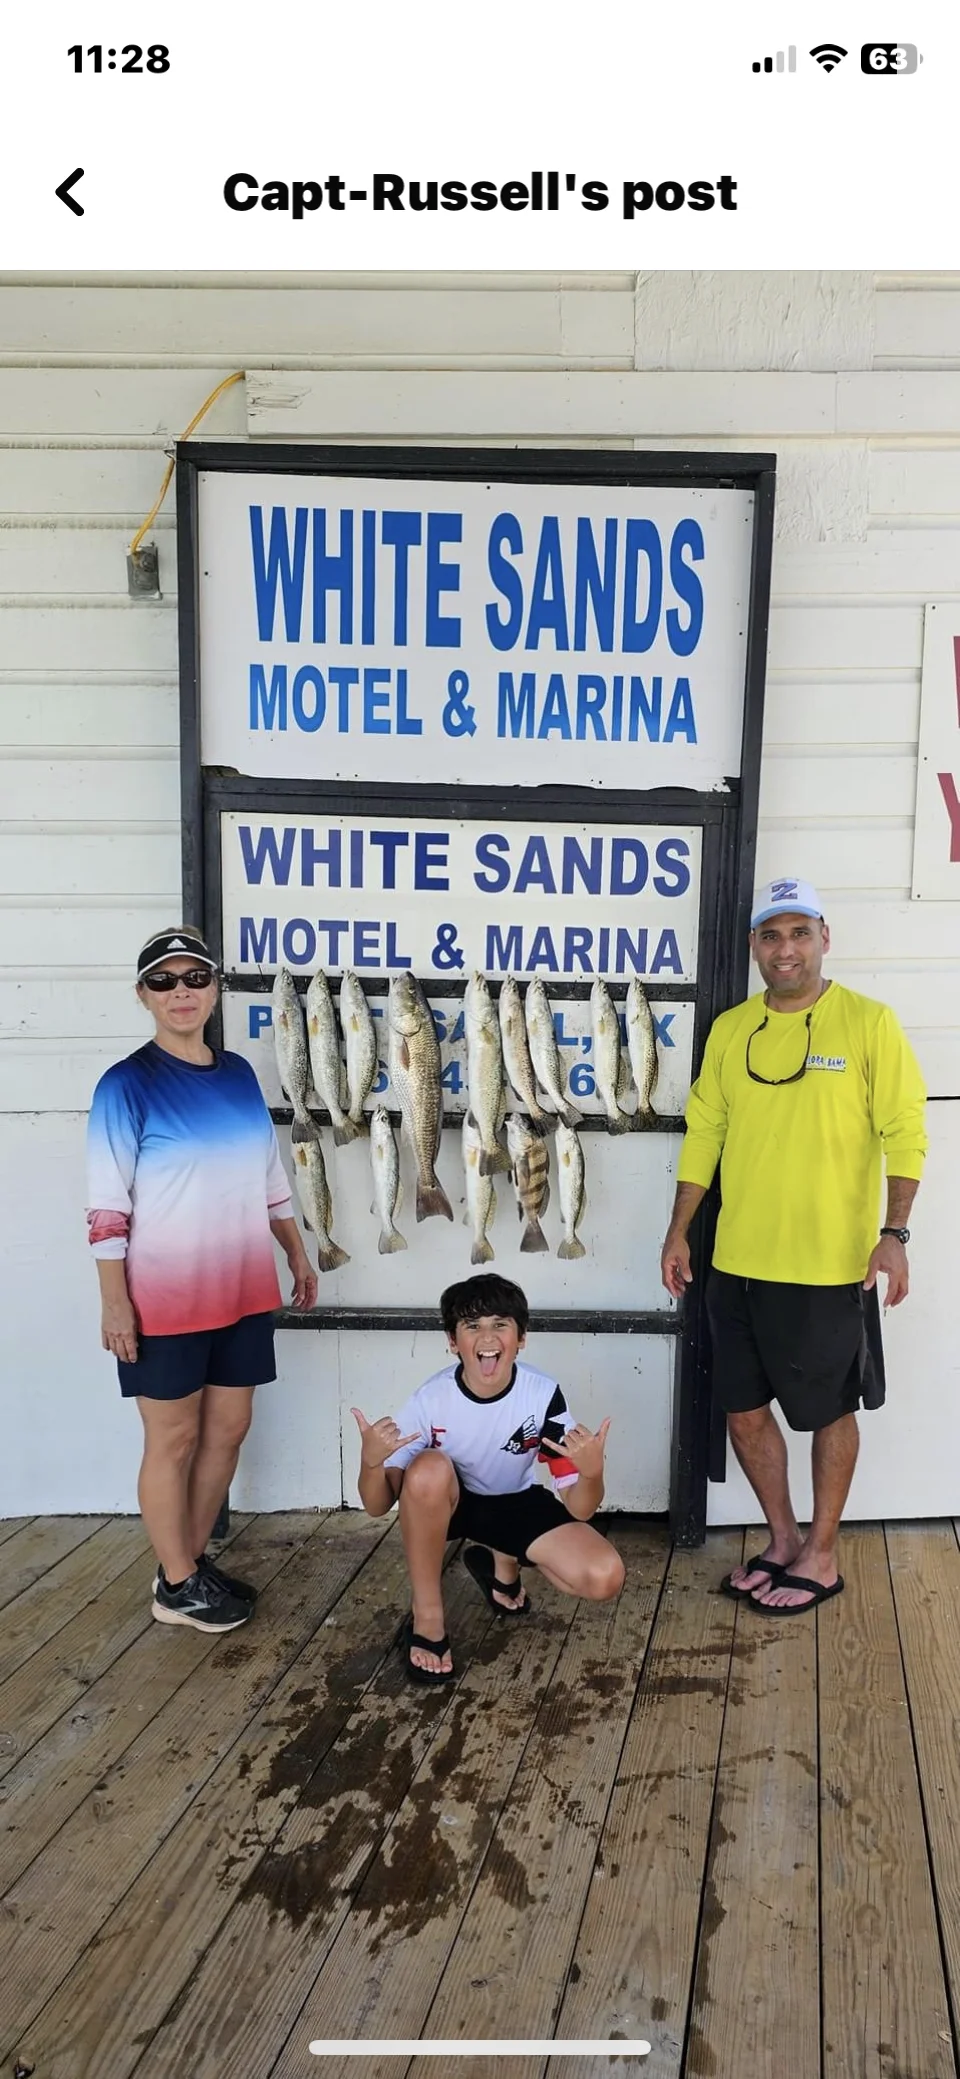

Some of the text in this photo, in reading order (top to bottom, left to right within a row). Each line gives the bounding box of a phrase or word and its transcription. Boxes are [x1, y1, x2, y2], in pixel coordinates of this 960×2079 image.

[249, 505, 705, 657] WHITE SANDS
[248, 663, 698, 744] MOTEL & MARINA
[239, 826, 691, 898] WHITE SANDS
[239, 917, 683, 975] MOTEL & MARINA
